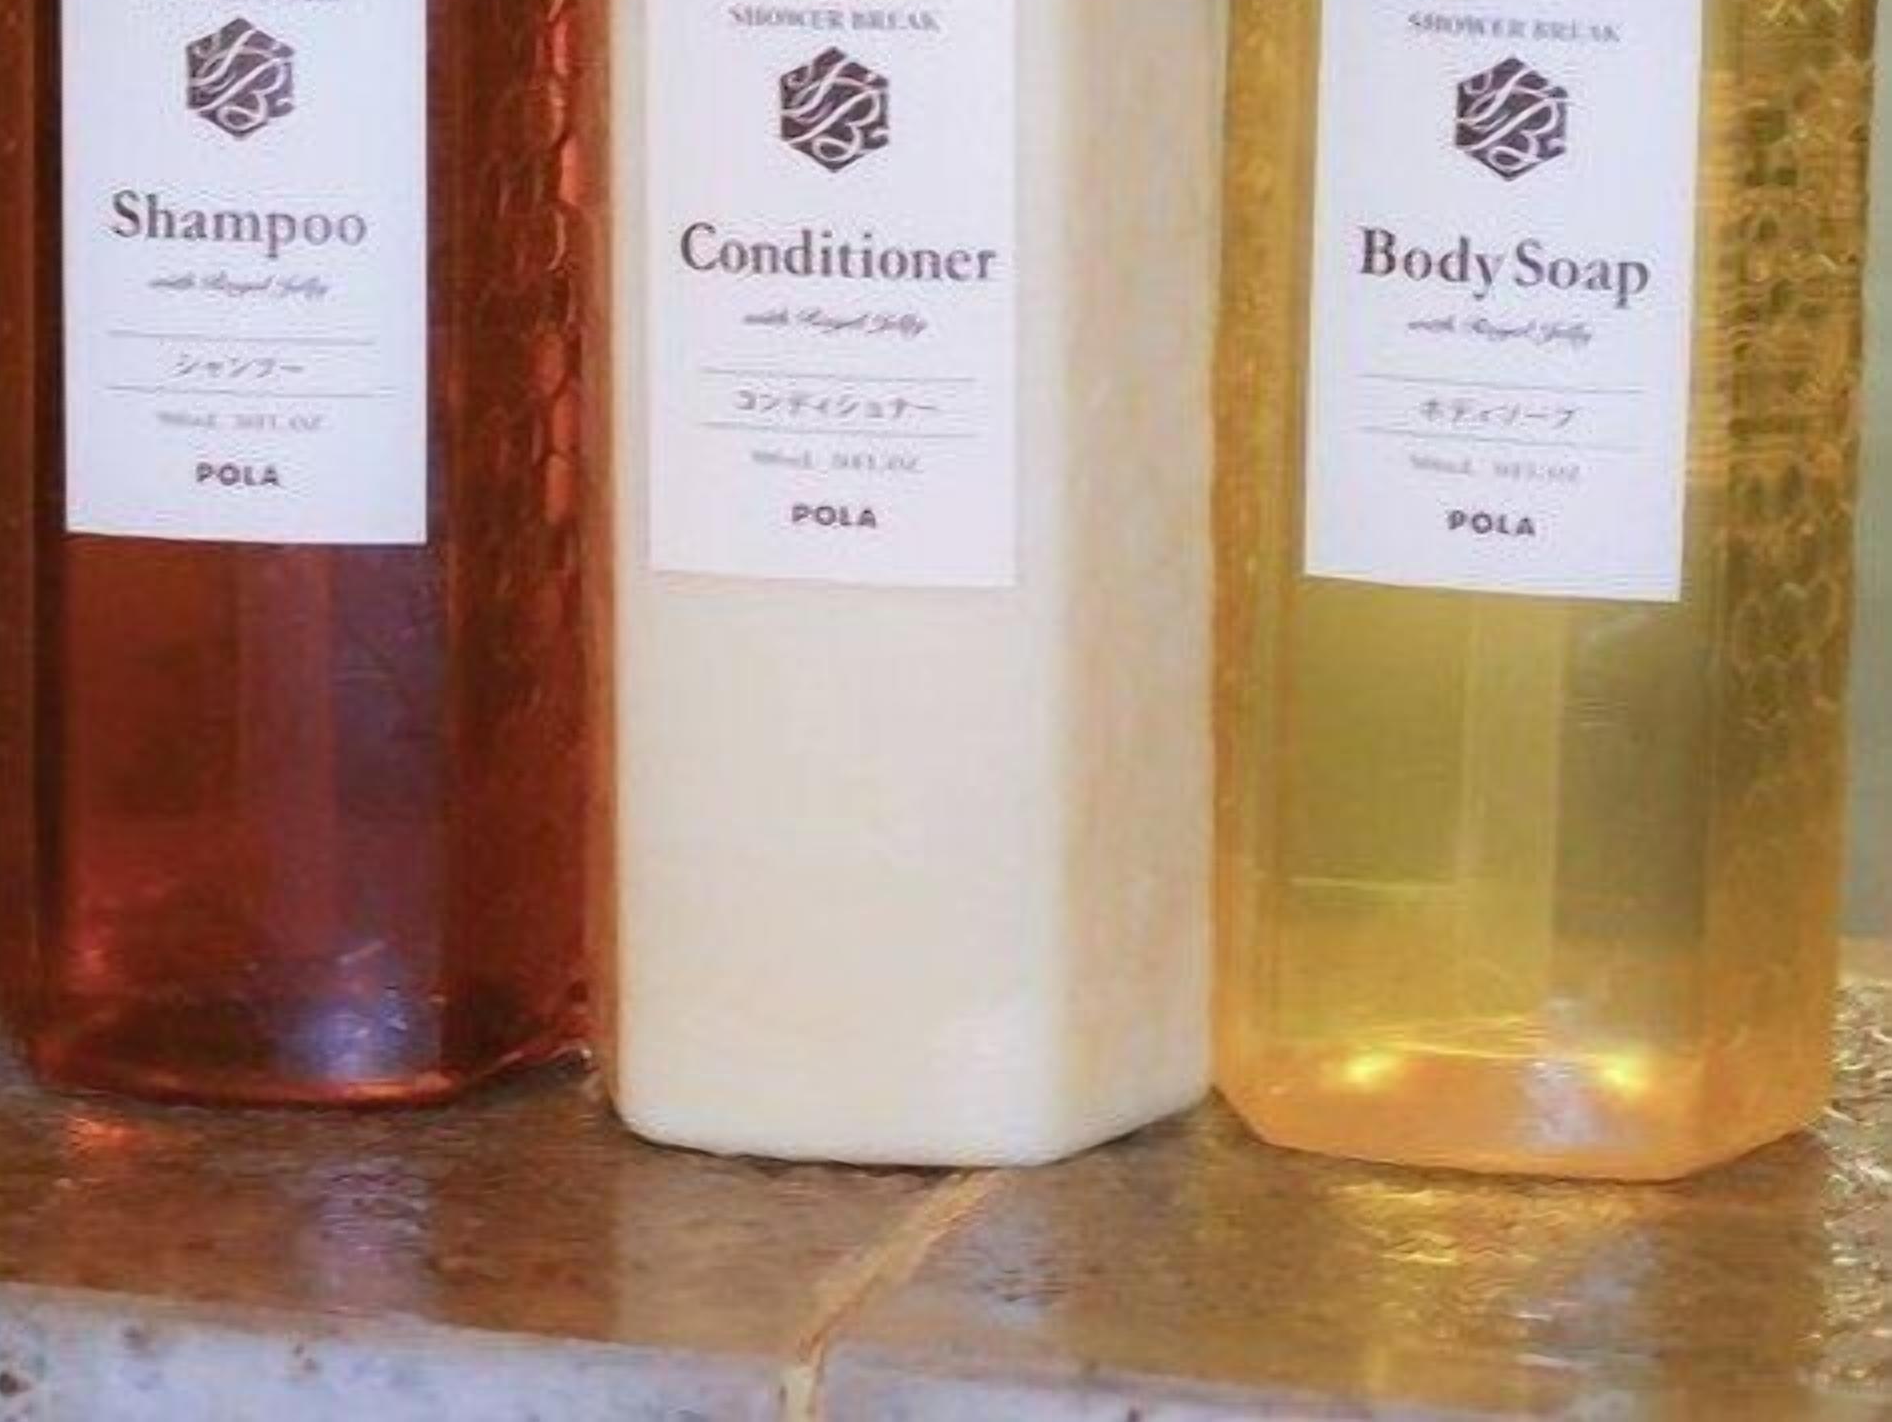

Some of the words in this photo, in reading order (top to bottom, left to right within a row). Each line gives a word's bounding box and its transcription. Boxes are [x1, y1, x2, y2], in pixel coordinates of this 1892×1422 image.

[728, 4, 845, 30] SHOWER
[852, 8, 940, 32] BREAK
[1408, 10, 1526, 39] SHOWER
[1532, 18, 1620, 43] BREAK
[111, 189, 368, 259] Shampoo
[680, 221, 997, 281] Conditioner
[1360, 226, 1504, 301] Body
[1514, 237, 1652, 309] Soap
[194, 461, 281, 487] POLA
[791, 503, 878, 528] POLA
[1447, 509, 1537, 537] POLA
